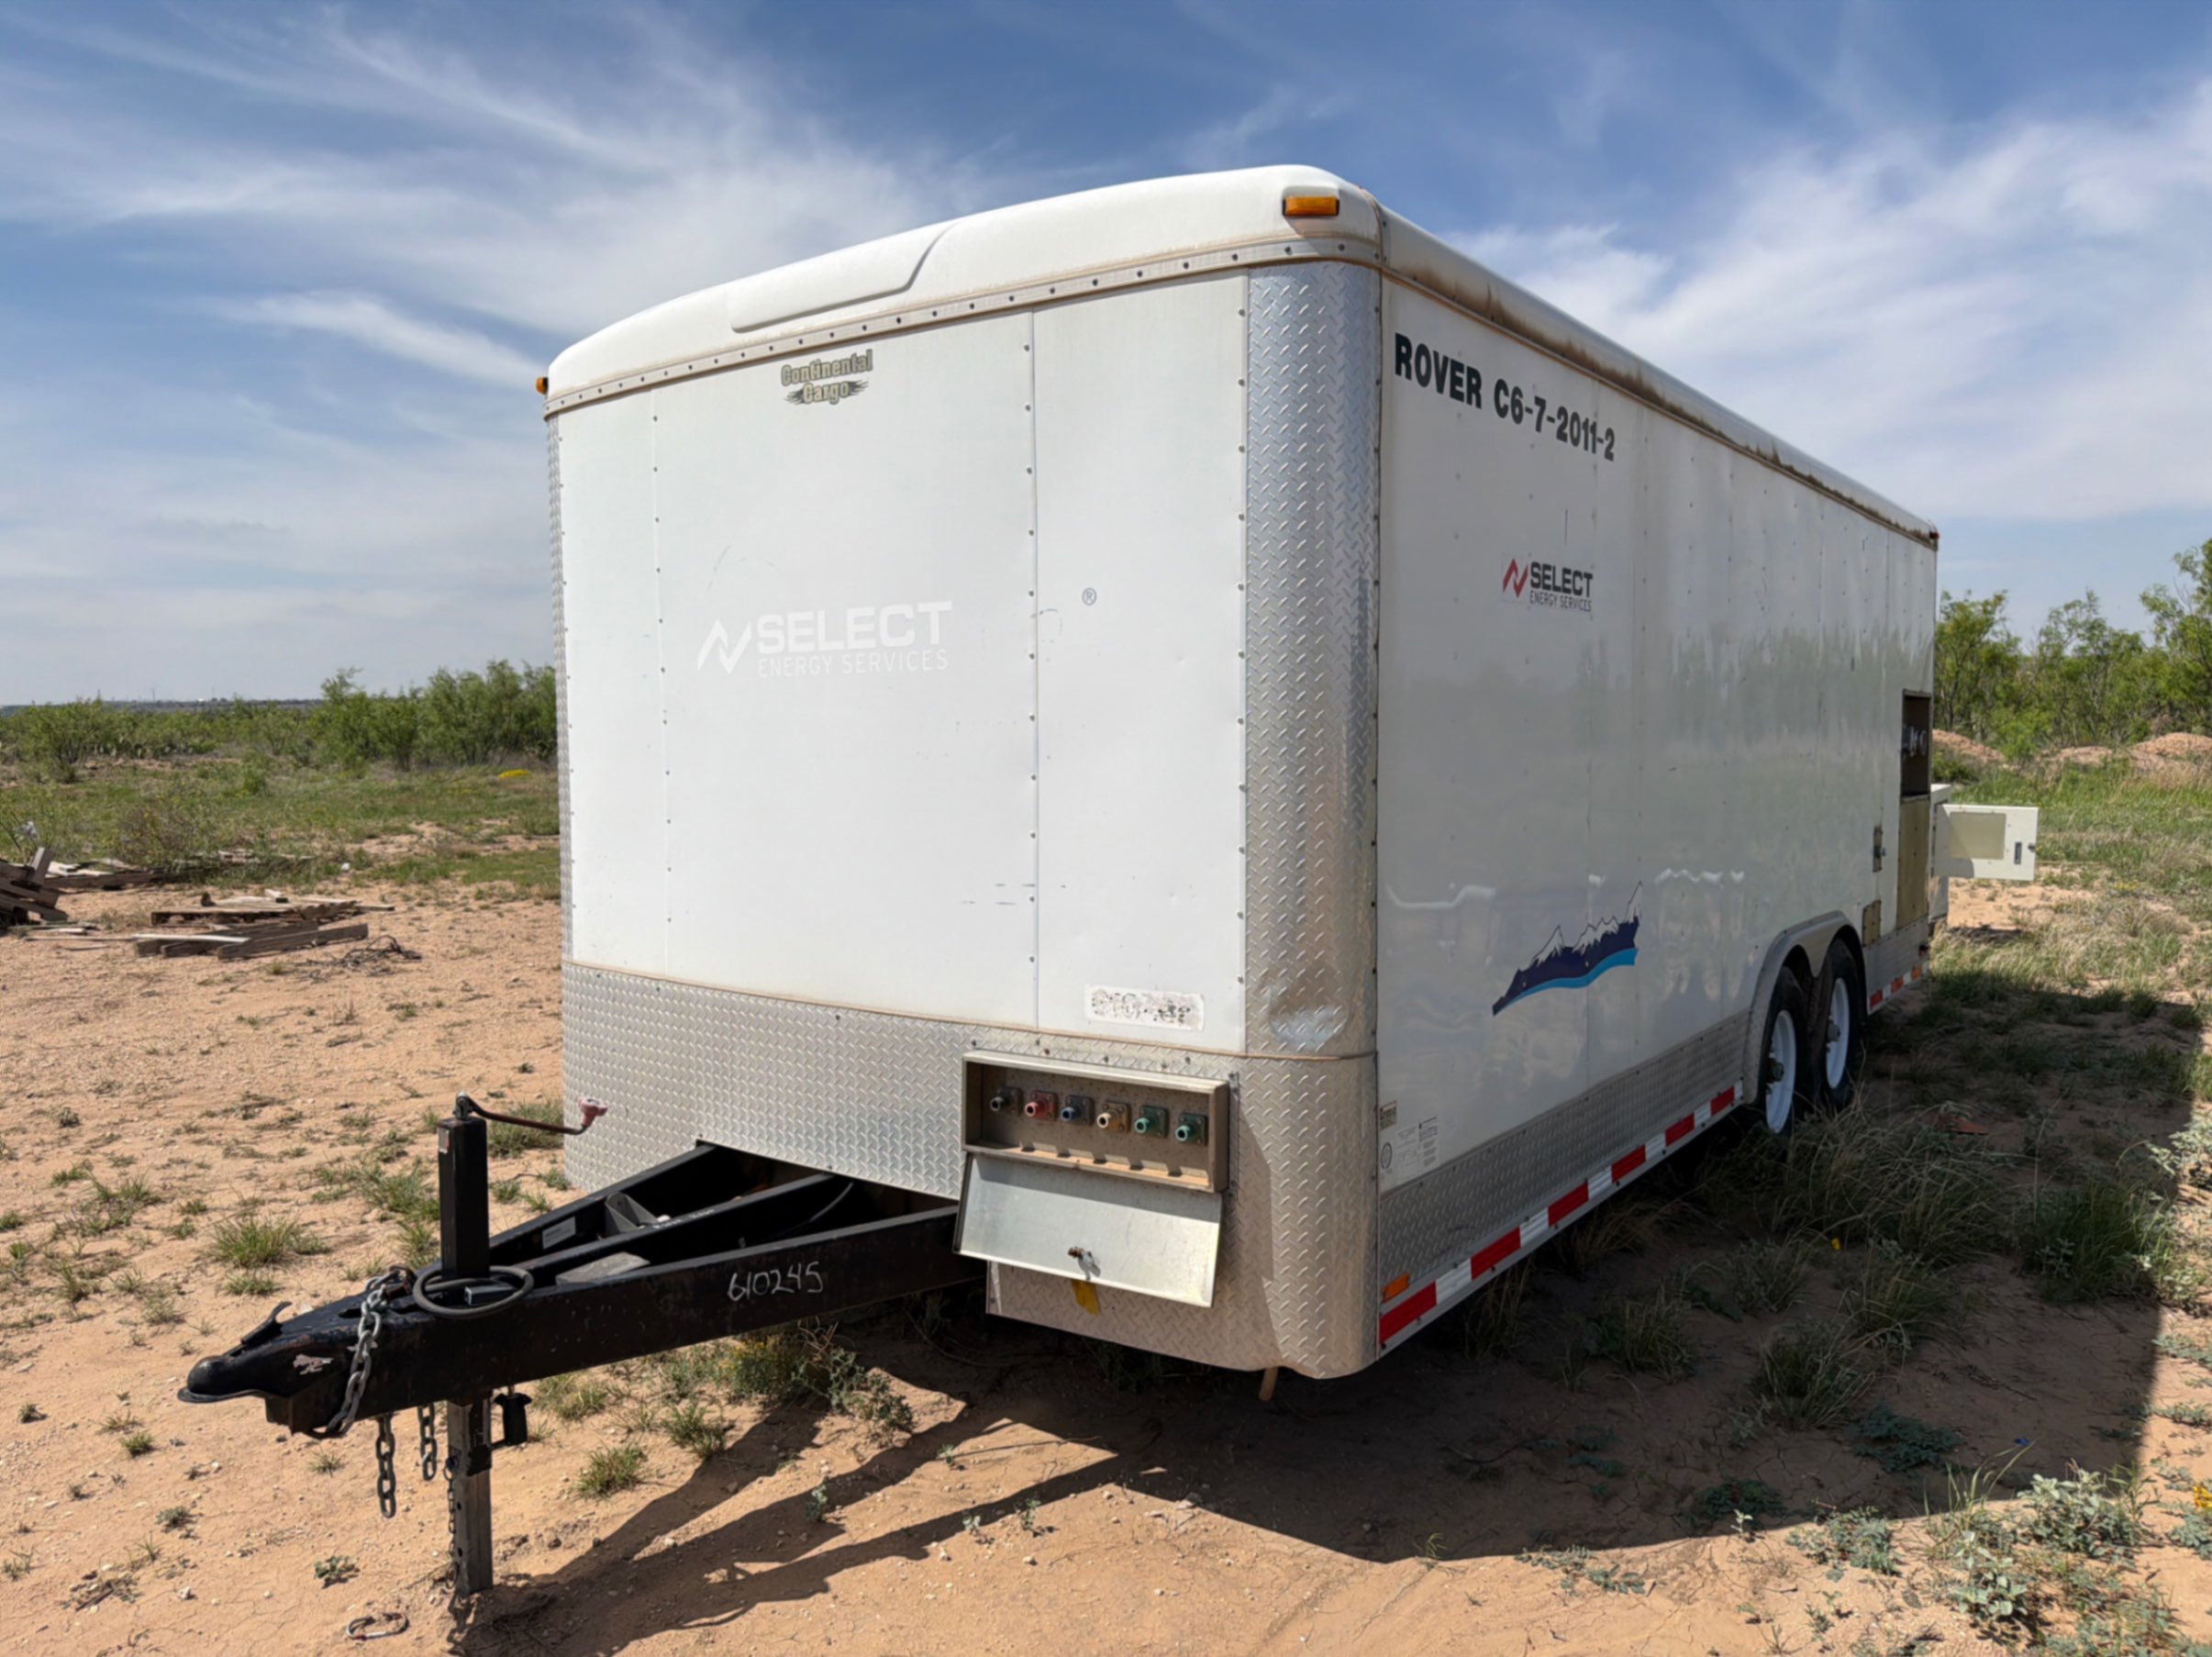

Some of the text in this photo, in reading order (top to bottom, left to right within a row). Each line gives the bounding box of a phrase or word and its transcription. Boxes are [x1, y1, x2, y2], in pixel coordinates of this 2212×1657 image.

[781, 349, 873, 386] Continental
[803, 382, 850, 405] Cargo
[1395, 332, 1615, 462] ROVER C6-7-2011-2
[1530, 561, 1593, 597] SELECT
[1529, 590, 1592, 612] ENERGY SERVICES
[757, 601, 952, 654] SELECT
[757, 649, 949, 677] ENERGY SERVICES
[728, 1261, 824, 1302] 610245
